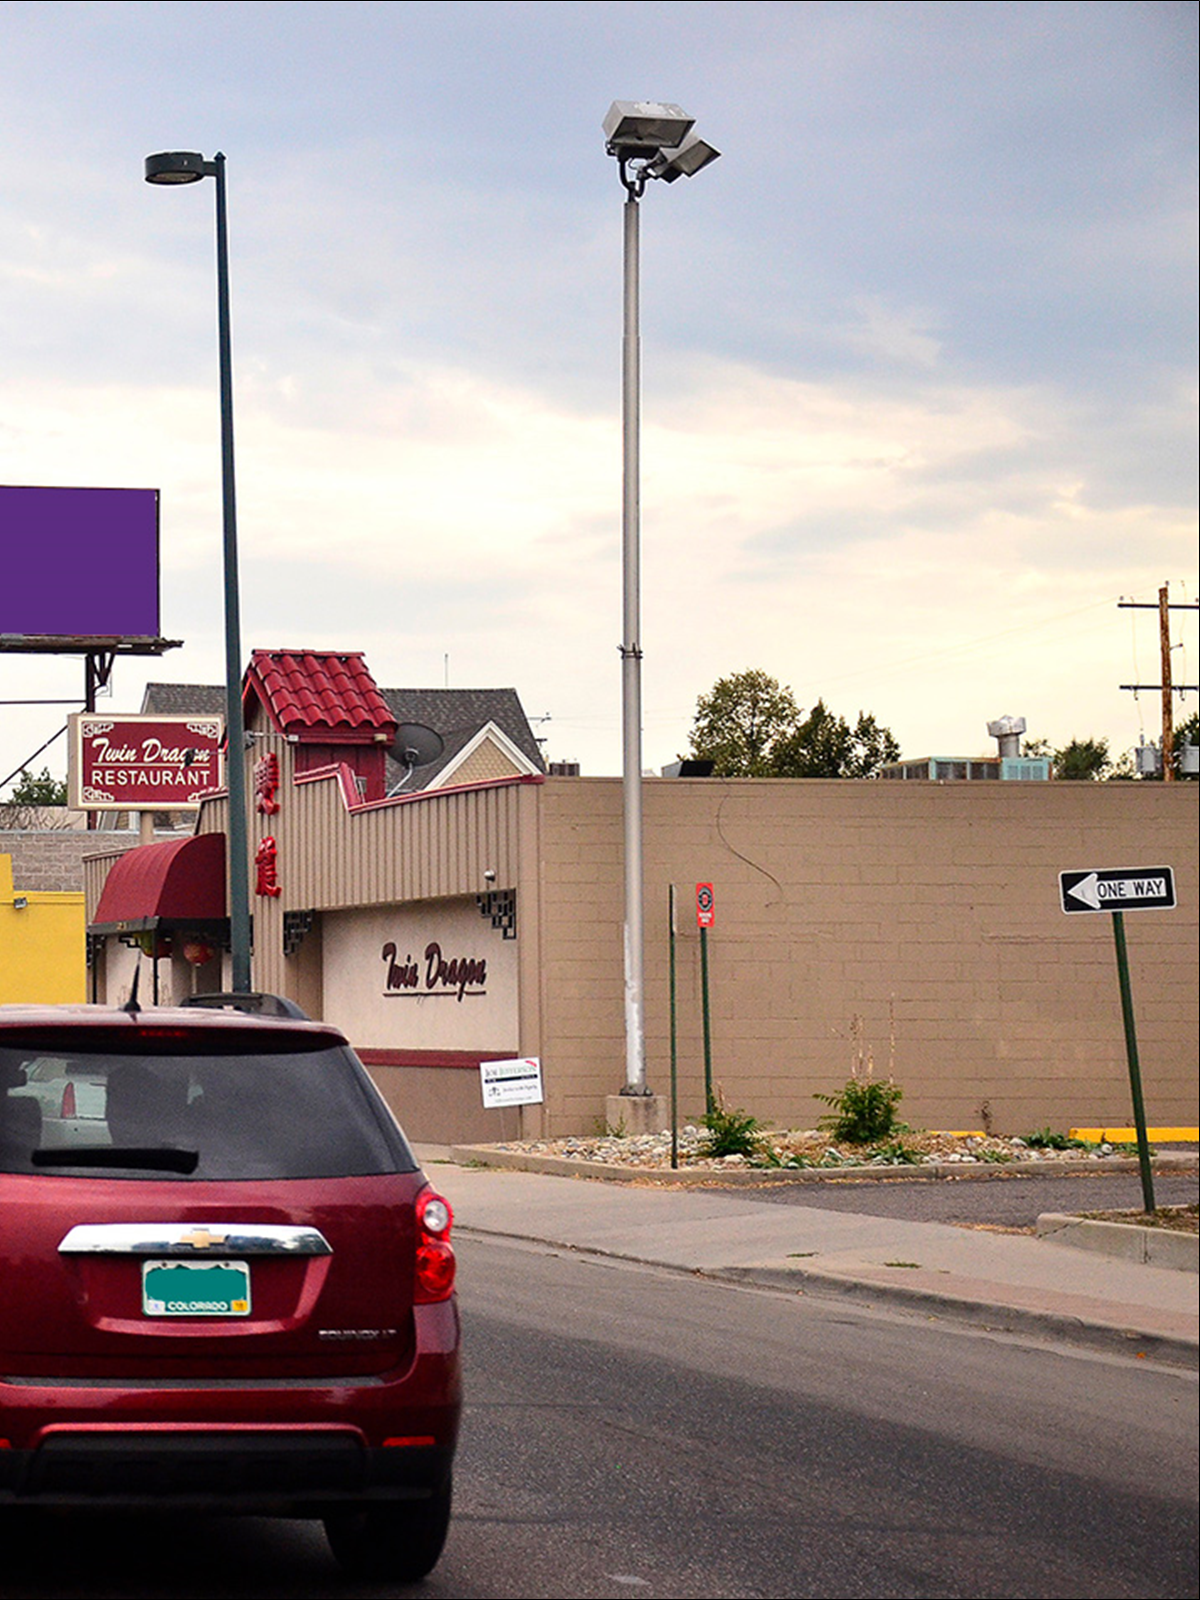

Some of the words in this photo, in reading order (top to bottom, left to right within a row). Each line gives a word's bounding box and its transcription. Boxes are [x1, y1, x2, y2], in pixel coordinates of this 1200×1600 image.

[92, 737, 138, 762] Twin
[92, 770, 210, 785] RESTAURANT
[1097, 881, 1127, 898] ONE
[1133, 880, 1163, 896] WAY
[382, 942, 419, 990] Twin
[425, 942, 487, 1002] Dragon
[167, 1301, 229, 1311] COLORADO
